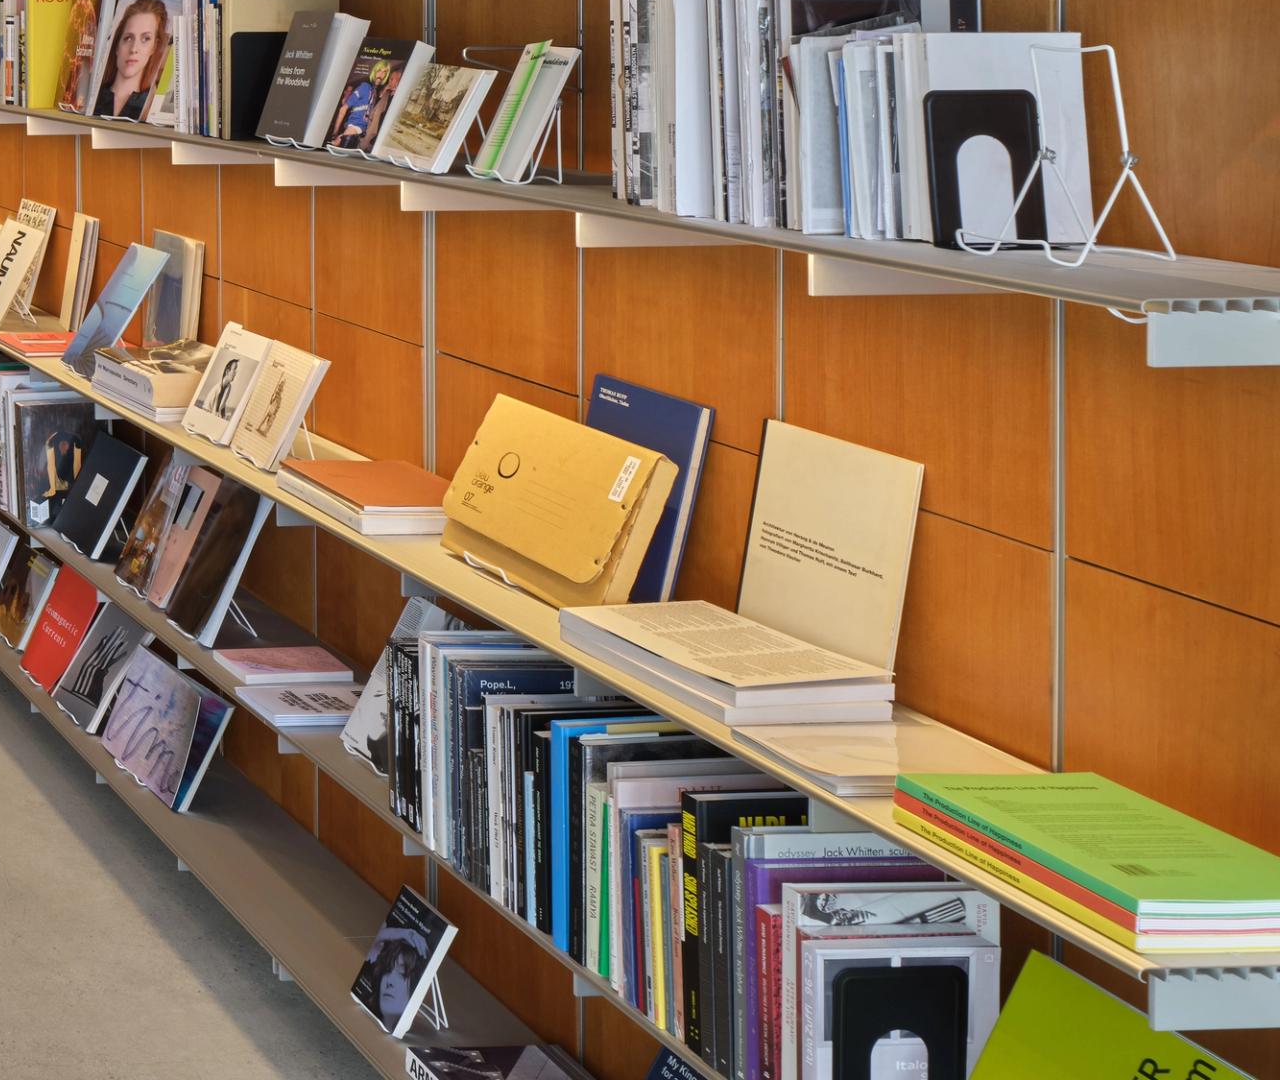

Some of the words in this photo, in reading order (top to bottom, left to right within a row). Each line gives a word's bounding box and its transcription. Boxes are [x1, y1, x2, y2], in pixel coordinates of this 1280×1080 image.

[284, 50, 296, 58] Jack
[296, 50, 313, 58] Whitten
[280, 66, 292, 74] Notes
[293, 66, 306, 74] from
[284, 78, 310, 86] Woodshed
[464, 492, 474, 502] 07
[471, 478, 494, 494] orange
[762, 521, 785, 532] Architektur
[794, 532, 808, 542] Herzog
[819, 542, 834, 552] Meuron
[45, 602, 79, 637] Geomagnetic
[42, 620, 67, 648] Currents
[480, 680, 516, 690] Pope.L,
[589, 794, 597, 828] PETRA
[682, 810, 695, 833] NARI
[922, 792, 933, 802] The
[935, 798, 966, 820] Production
[967, 816, 980, 828] Line
[989, 826, 1023, 850] Happiness
[683, 833, 696, 859] WARD
[922, 808, 932, 818] The
[934, 814, 966, 836] Production
[966, 831, 979, 843] Line
[980, 838, 988, 846] of
[988, 842, 1022, 866] Happiness
[778, 849, 816, 858] odyssey
[823, 848, 844, 858] Jack
[846, 846, 884, 857] Whitten
[920, 825, 932, 836] The
[932, 831, 964, 852] Production
[965, 848, 978, 860] Line
[979, 856, 986, 864] of
[986, 860, 1020, 884] Happiness
[684, 872, 697, 893] SUN
[734, 870, 743, 902] odyssey
[590, 884, 598, 919] RAMYA
[684, 893, 698, 937] SPLASHED
[735, 905, 743, 924] Jack
[736, 926, 744, 956] Whitten
[735, 959, 744, 994] sculpture
[805, 1004, 815, 1036] Zuffi
[666, 1055, 677, 1067] My
[806, 1038, 816, 1066] Italo
[896, 1060, 928, 1070] Italo
[662, 1066, 673, 1079] for
